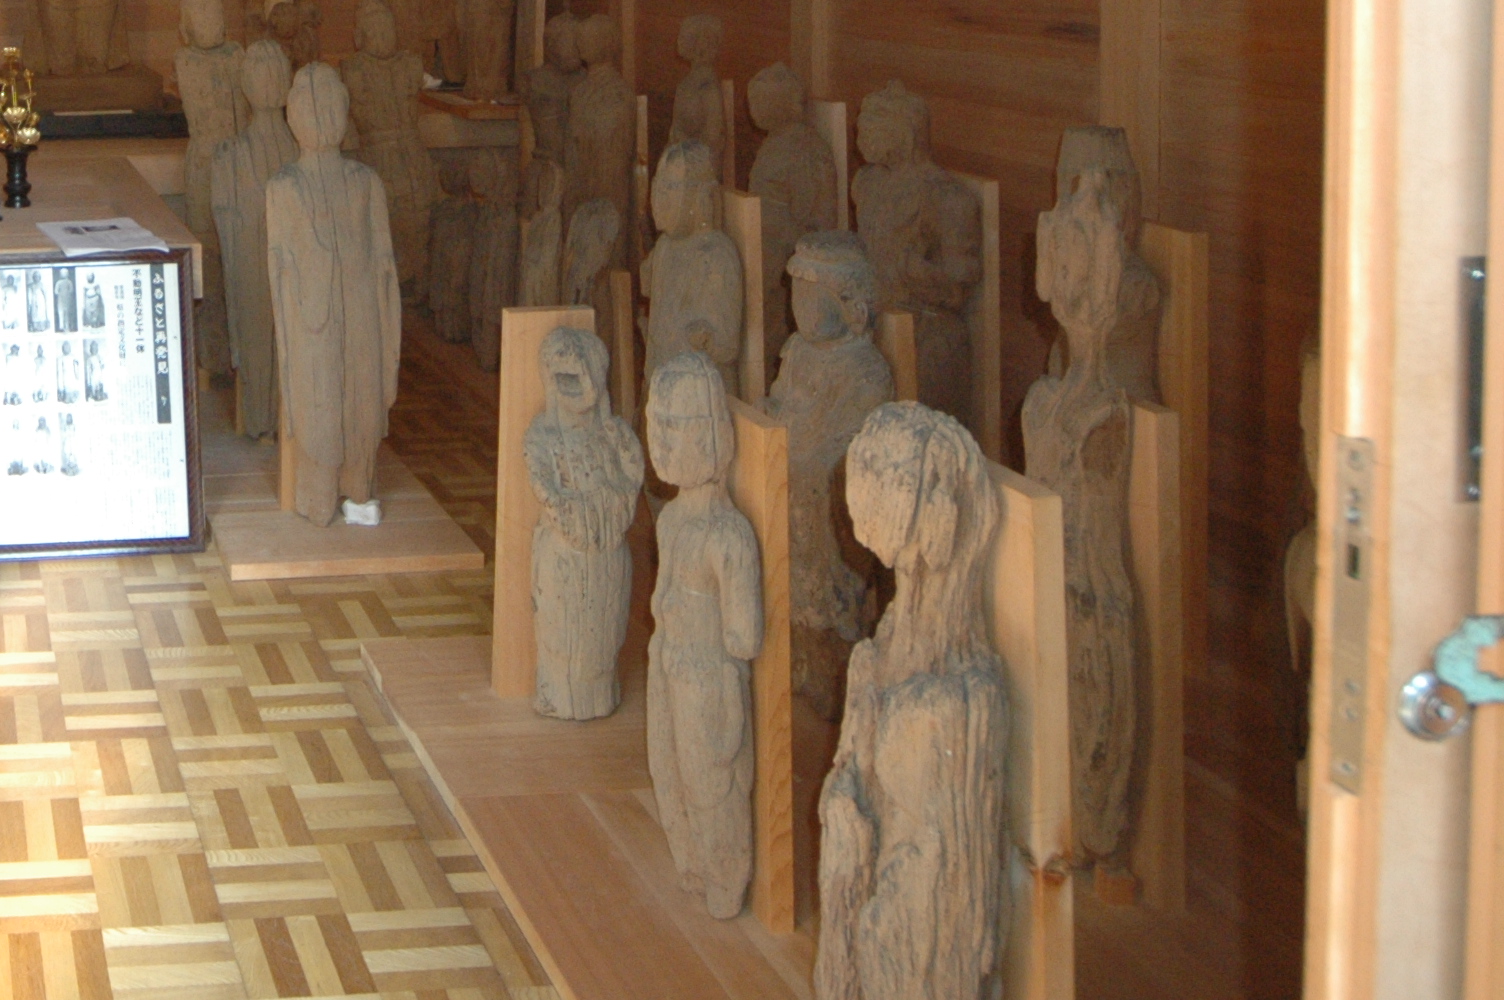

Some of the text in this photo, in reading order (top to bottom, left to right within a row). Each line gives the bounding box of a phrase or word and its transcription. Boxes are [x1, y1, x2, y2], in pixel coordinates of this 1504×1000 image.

[152, 273, 169, 374] ふるさと再発見
